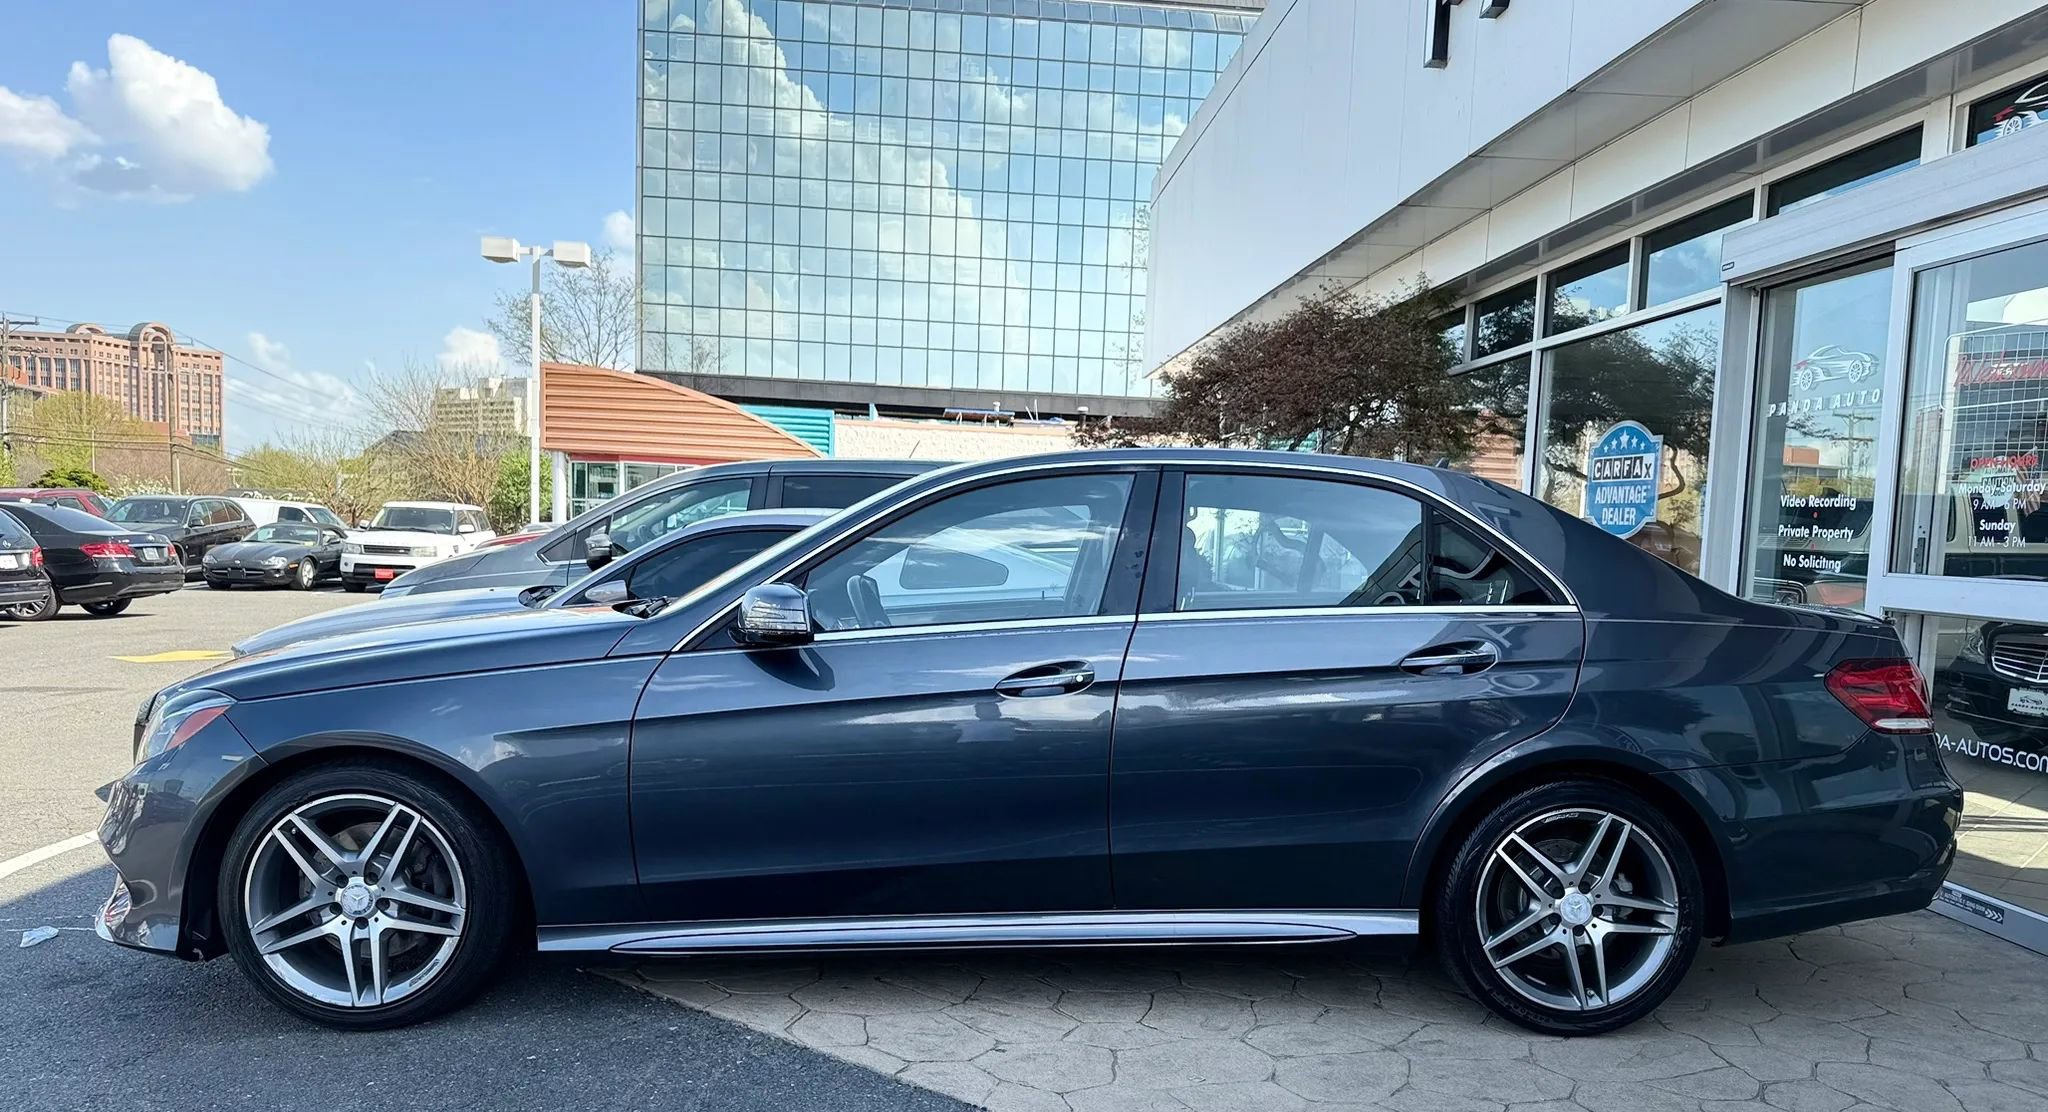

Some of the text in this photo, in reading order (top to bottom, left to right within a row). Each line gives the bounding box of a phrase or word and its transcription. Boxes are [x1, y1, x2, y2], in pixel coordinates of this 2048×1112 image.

[1768, 396, 1823, 417] PANDA
[1594, 459, 1652, 479] CARFAX
[1595, 486, 1647, 504] ADVANTAGE
[1958, 480, 2046, 496] Monday-Saturday
[1780, 494, 1857, 511] Video Recording
[1973, 499, 1979, 510] 9
[1981, 500, 1995, 510] AM
[2012, 498, 2026, 510] PM
[1601, 507, 1636, 525] DEALER
[1778, 524, 1855, 542] Private Property
[1979, 518, 2016, 533] Sunday
[1968, 536, 1976, 548] 11
[1979, 537, 1995, 548] AM
[2003, 537, 2009, 548] 3
[2012, 536, 2026, 548] PM
[1783, 554, 1842, 573] No Soliciting
